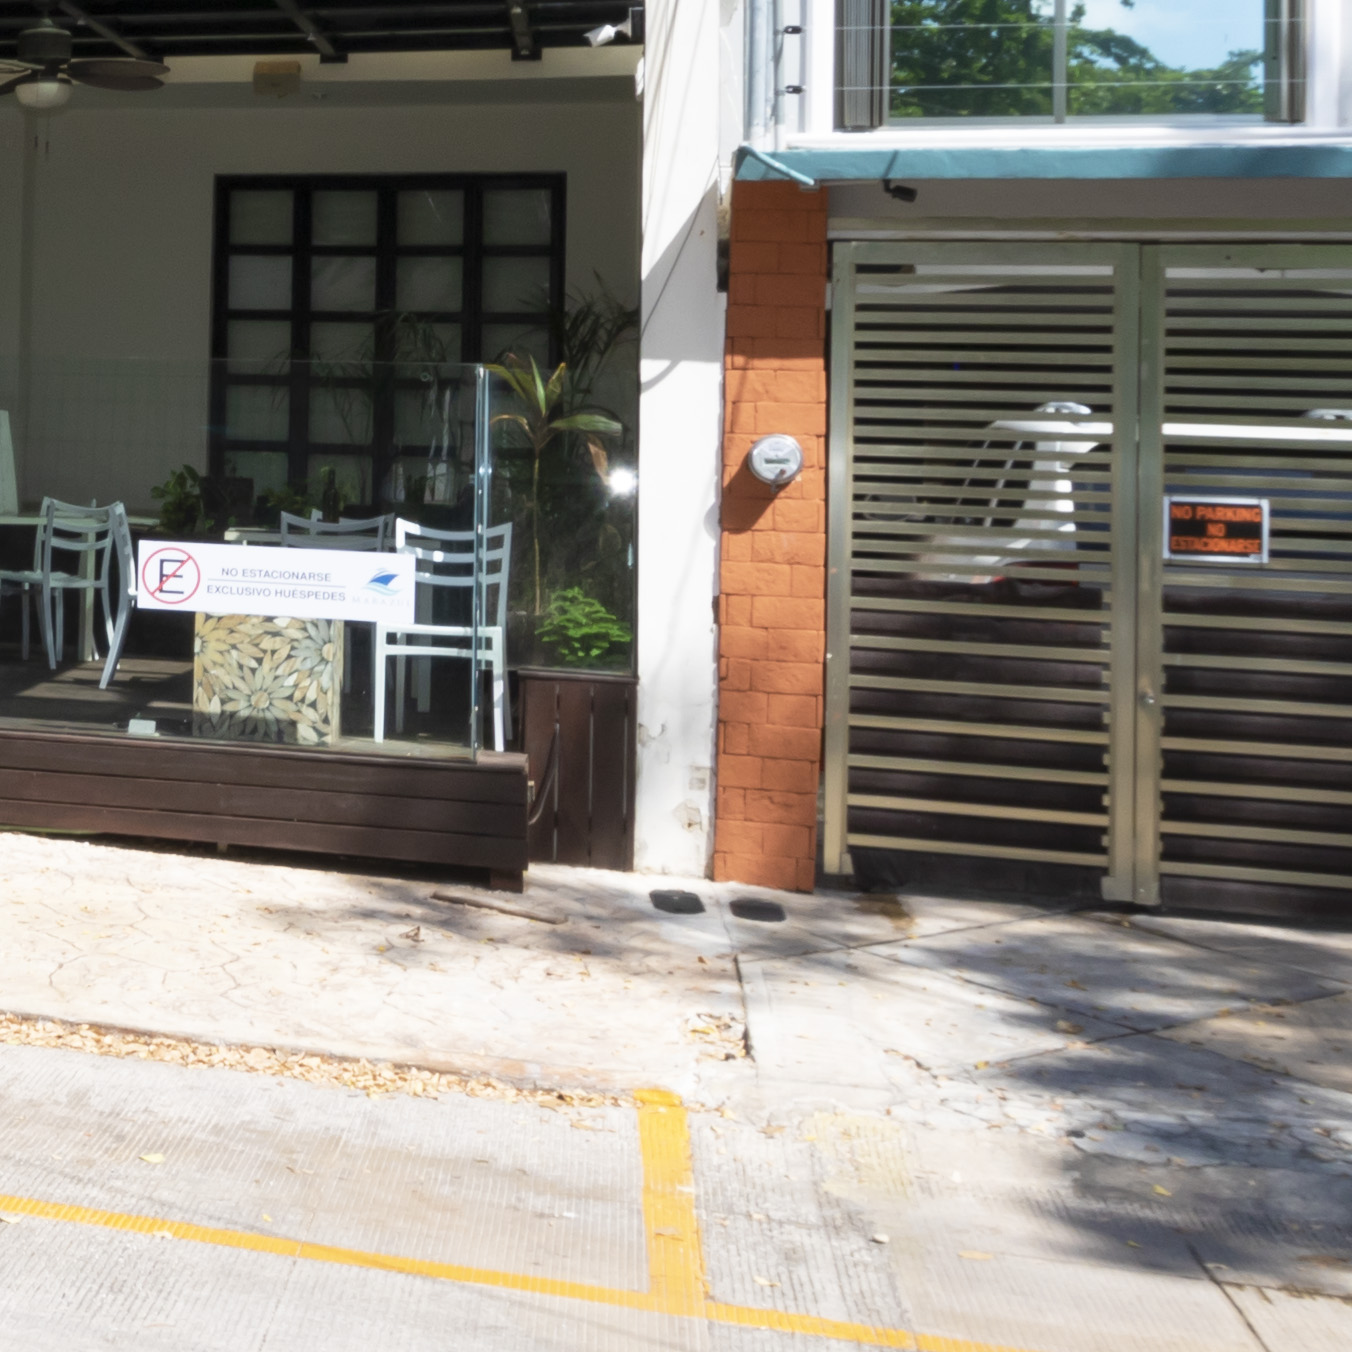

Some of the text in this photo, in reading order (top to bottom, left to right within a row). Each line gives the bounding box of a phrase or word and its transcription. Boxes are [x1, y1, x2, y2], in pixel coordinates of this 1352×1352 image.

[1171, 505, 1261, 522] NO PARKING
[1207, 522, 1227, 537] NO
[221, 568, 332, 582] NO ESTACIONARSE
[207, 584, 346, 602] EXCLUSIVO HUÉSPEDES
